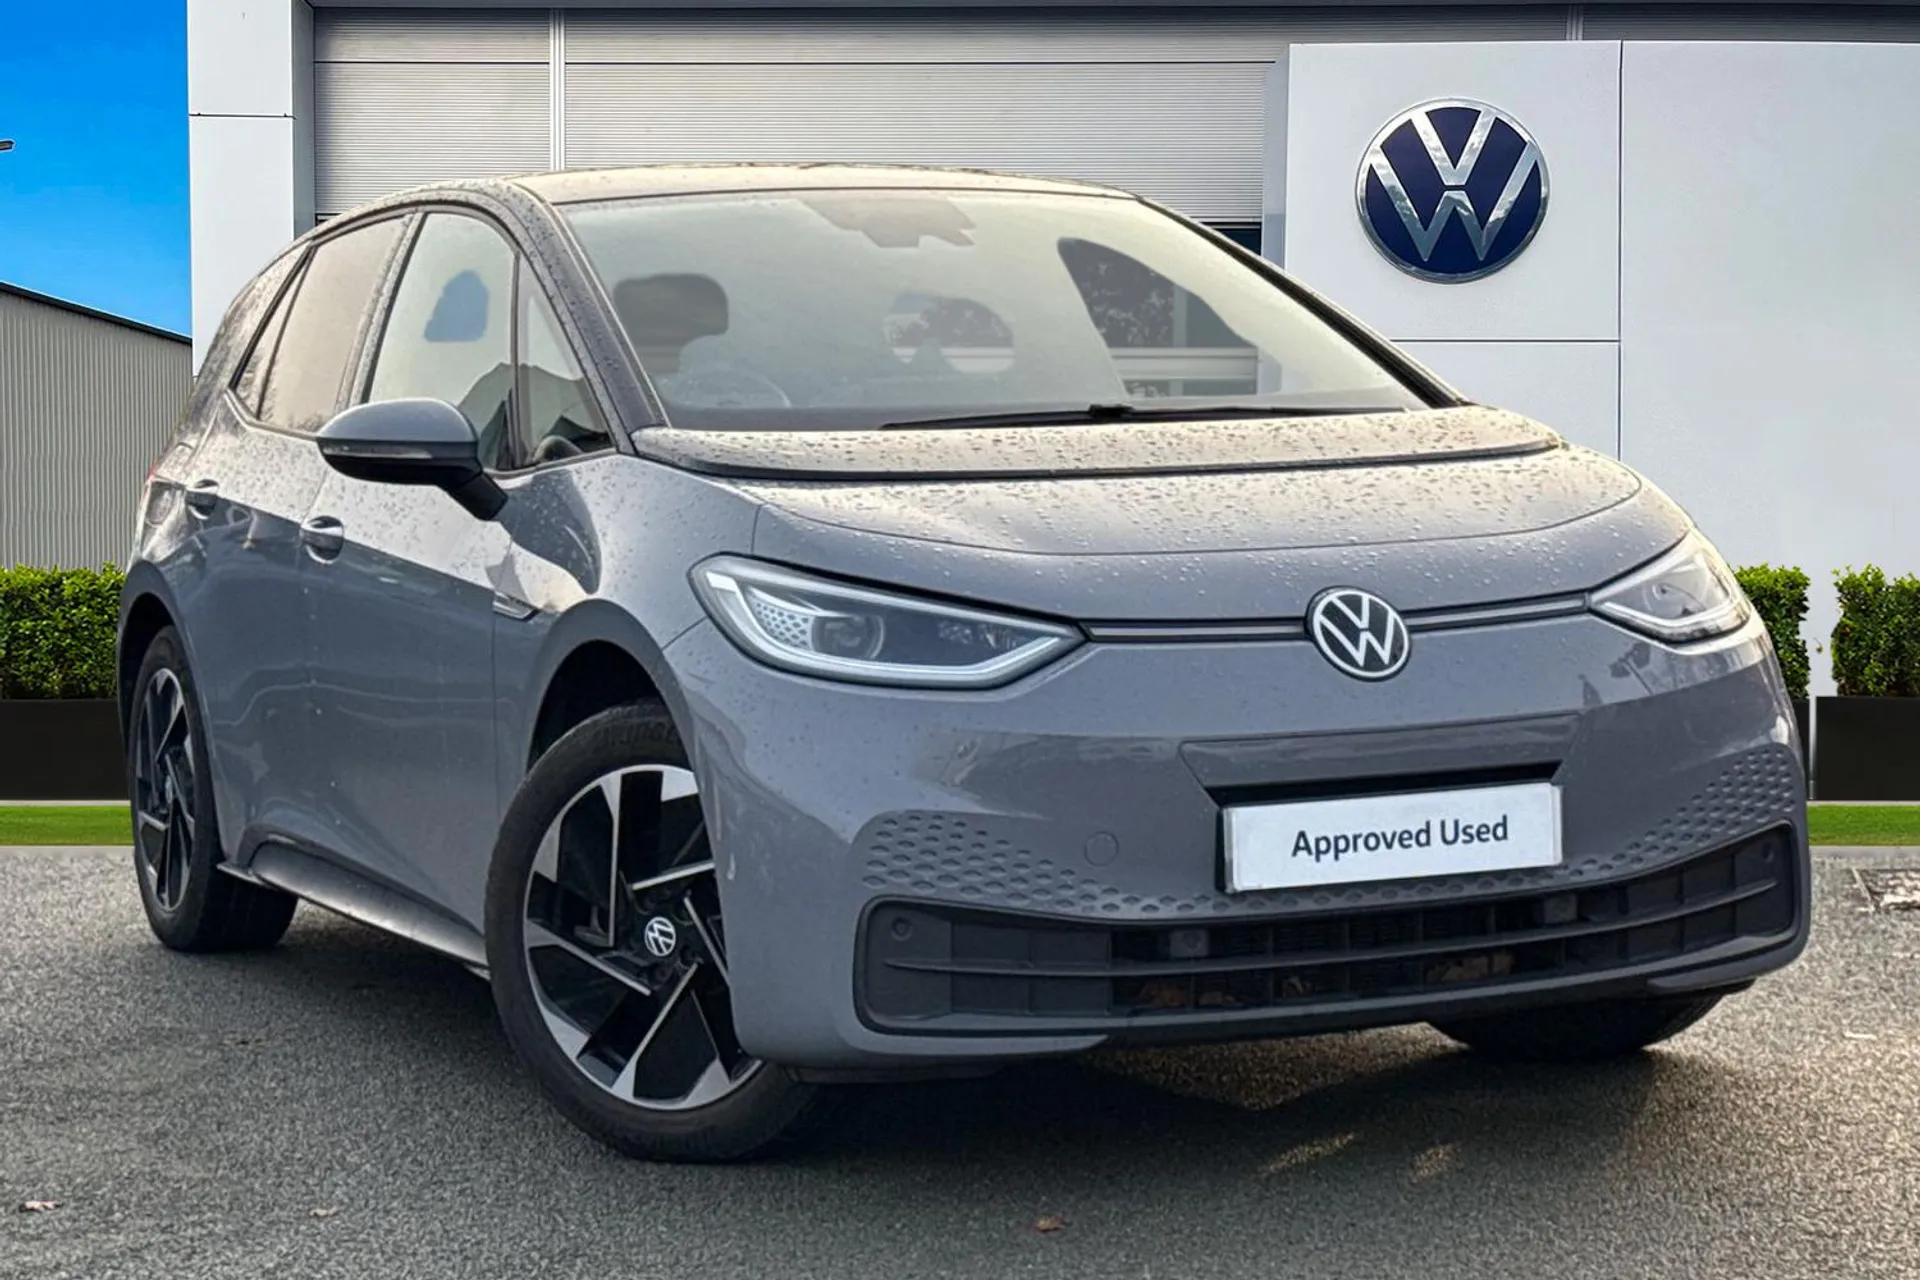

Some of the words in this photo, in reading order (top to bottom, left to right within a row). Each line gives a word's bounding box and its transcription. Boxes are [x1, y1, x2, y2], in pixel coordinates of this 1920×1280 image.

[1366, 102, 1544, 264] VW
[1314, 592, 1402, 671] VW
[1291, 820, 1431, 862] Approved
[1440, 815, 1508, 845] Used
